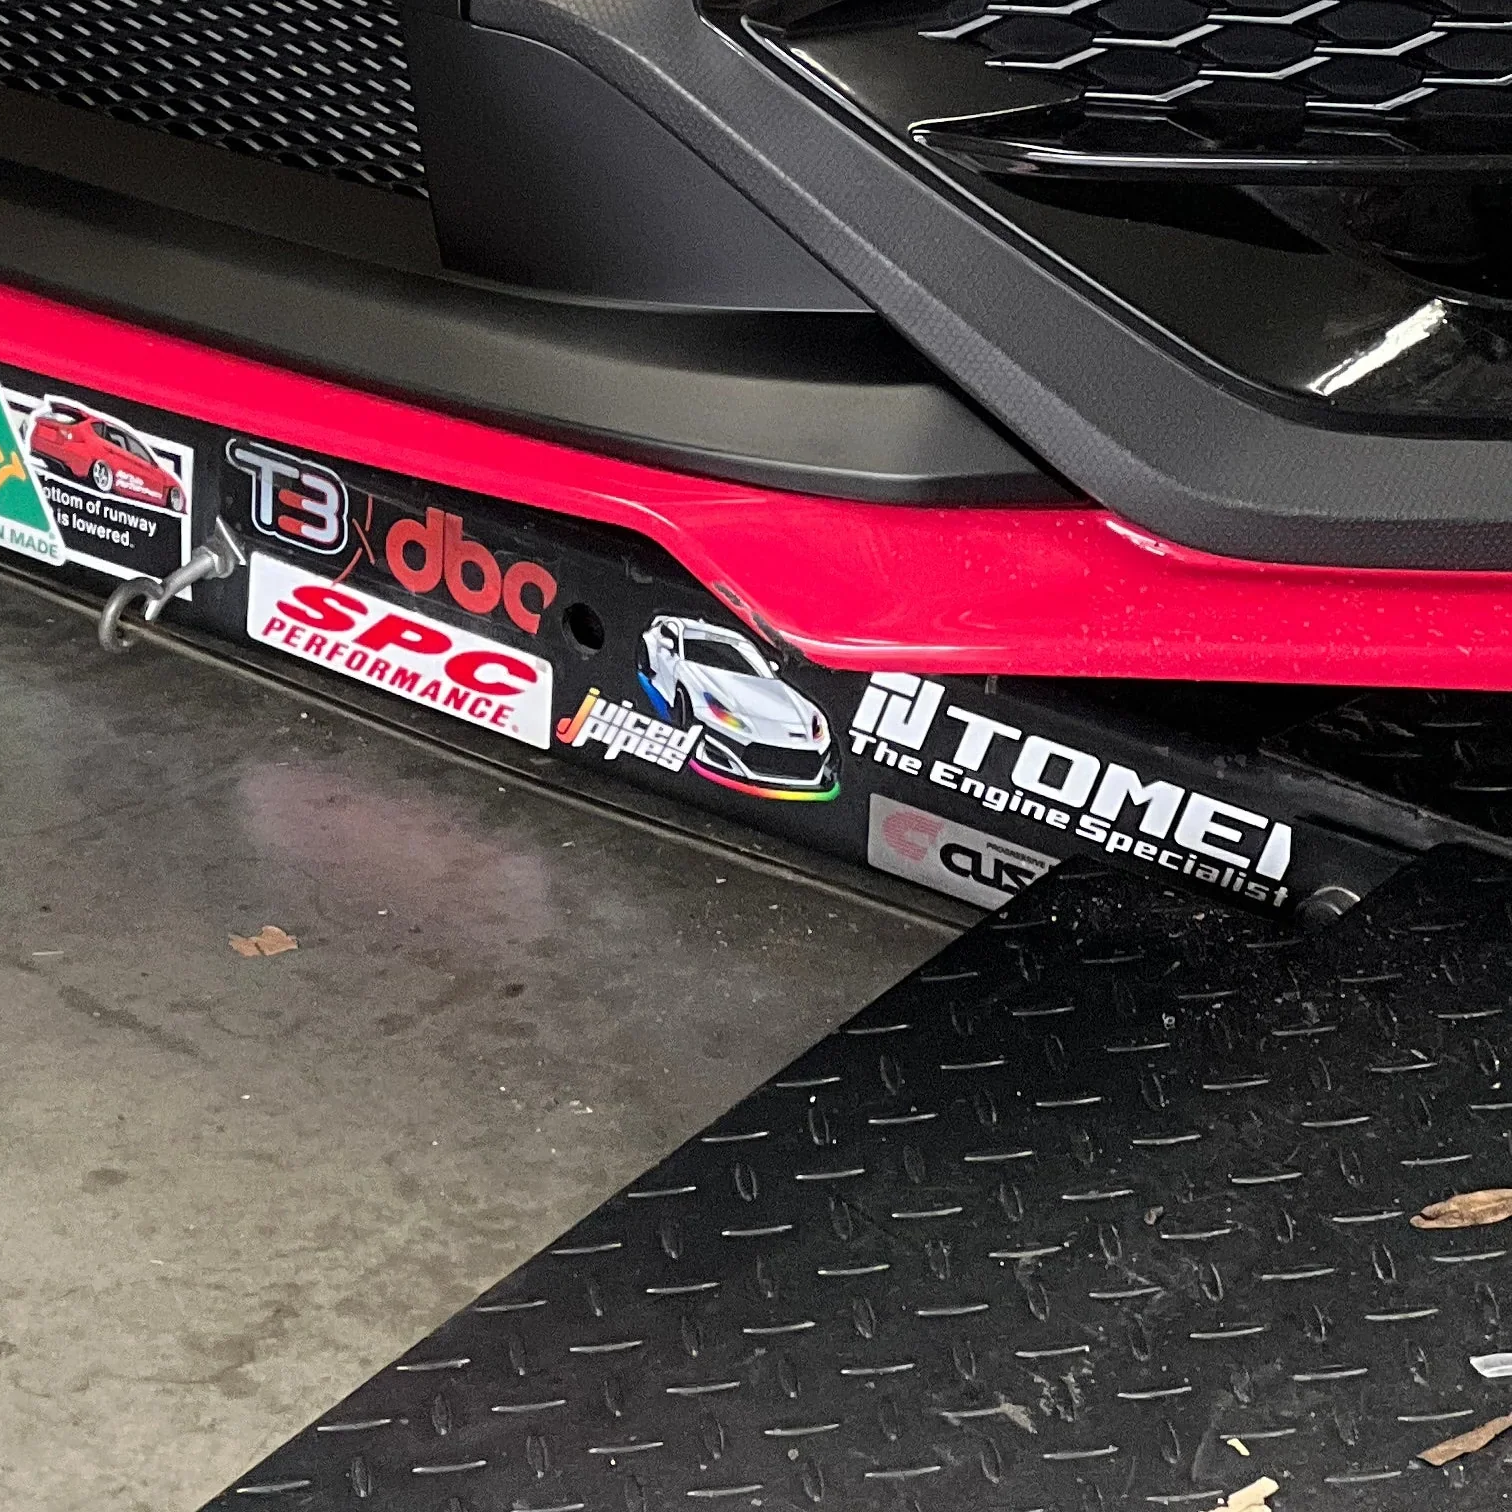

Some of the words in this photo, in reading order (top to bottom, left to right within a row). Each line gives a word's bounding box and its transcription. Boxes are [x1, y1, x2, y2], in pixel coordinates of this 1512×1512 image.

[9, 528, 59, 559] MADE
[42, 485, 84, 511] ottom
[85, 498, 102, 516] of
[103, 506, 157, 538] runway
[56, 507, 70, 527] is
[385, 505, 559, 635] dbc
[261, 616, 515, 728] PERFORMANCE
[276, 584, 538, 697] SPC
[848, 728, 922, 776] The
[929, 760, 1070, 831] Engine
[1075, 812, 1290, 909] Specialist
[946, 704, 1293, 881] TOMEI
